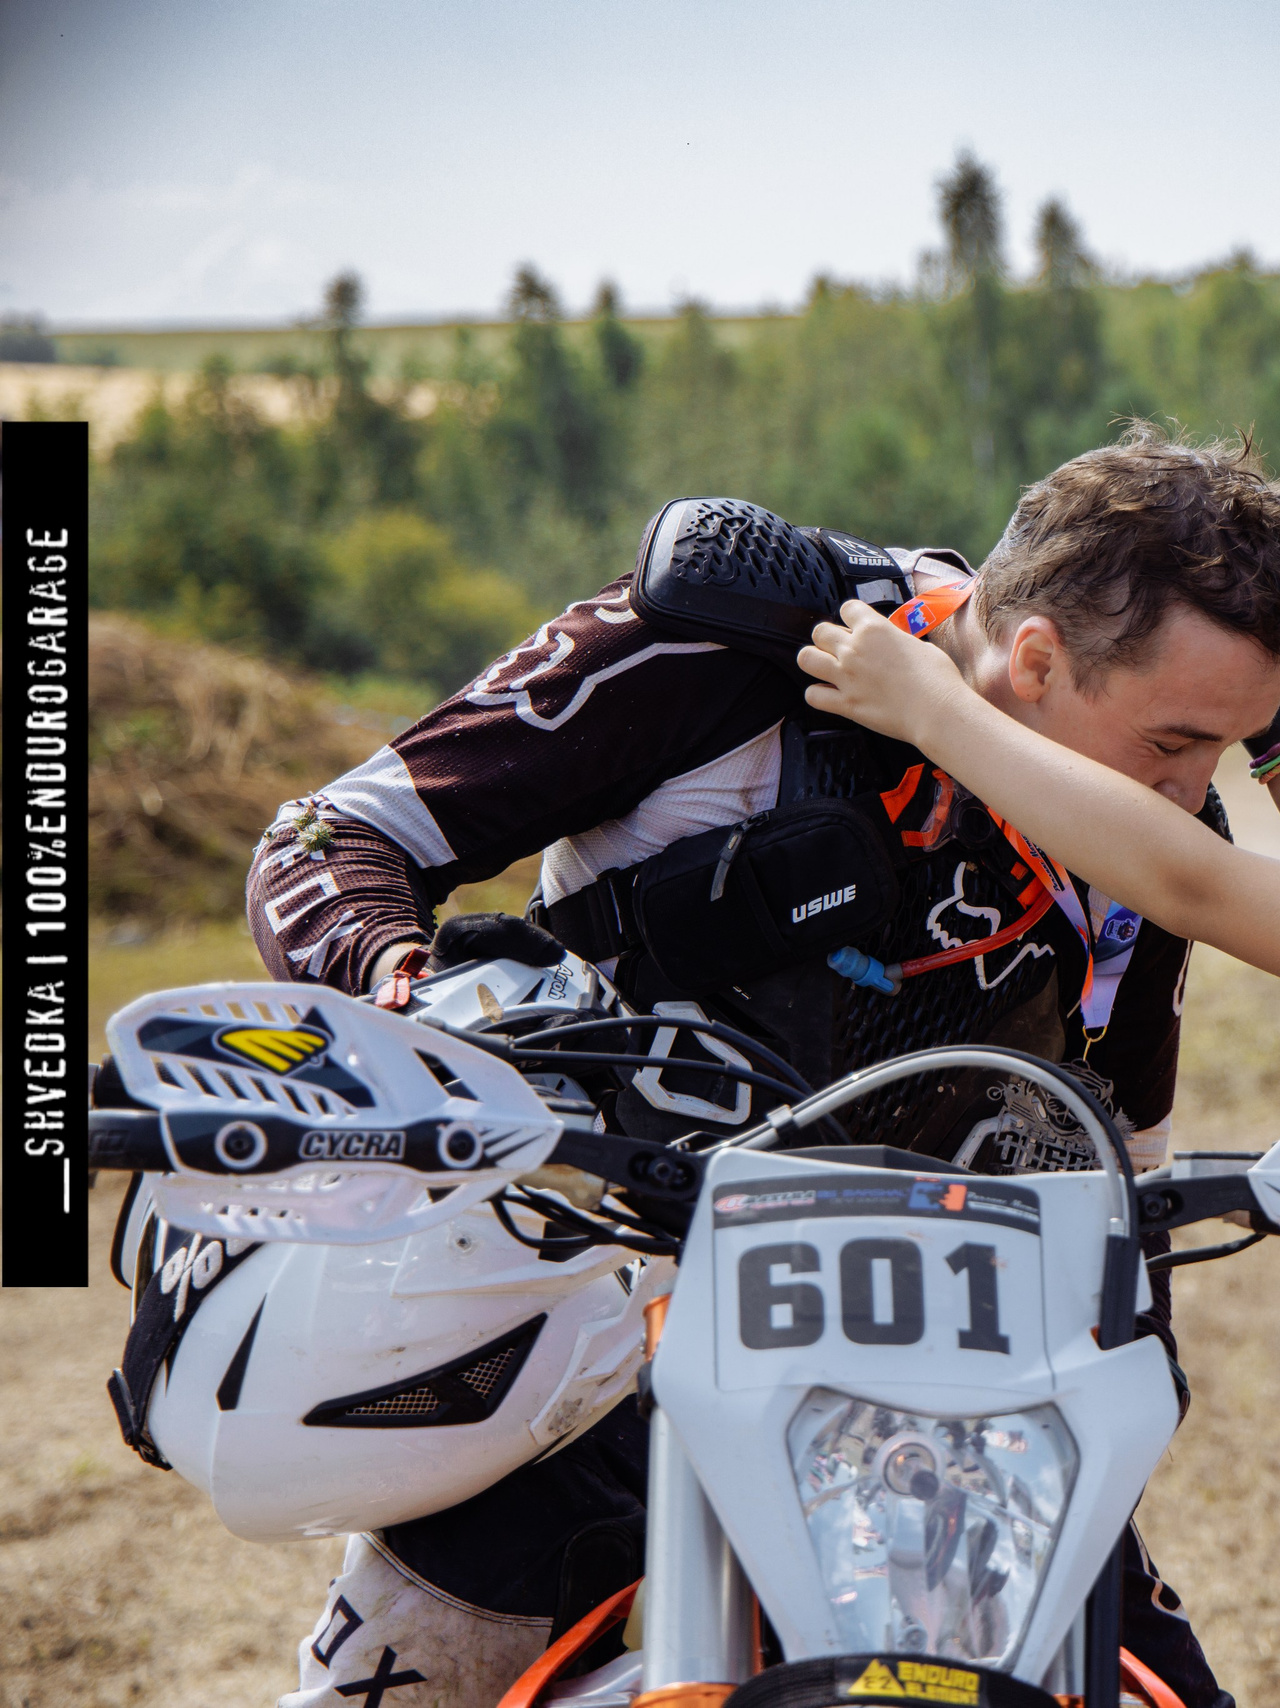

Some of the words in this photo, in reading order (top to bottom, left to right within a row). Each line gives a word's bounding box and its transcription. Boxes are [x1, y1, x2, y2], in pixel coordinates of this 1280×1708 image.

[848, 556, 892, 567] USWE
[790, 883, 857, 924] USWE
[548, 964, 573, 1000] Airoh
[300, 1130, 406, 1161] CYCRA
[737, 1236, 1011, 1356] 601
[896, 1660, 980, 1692] ENDURO
